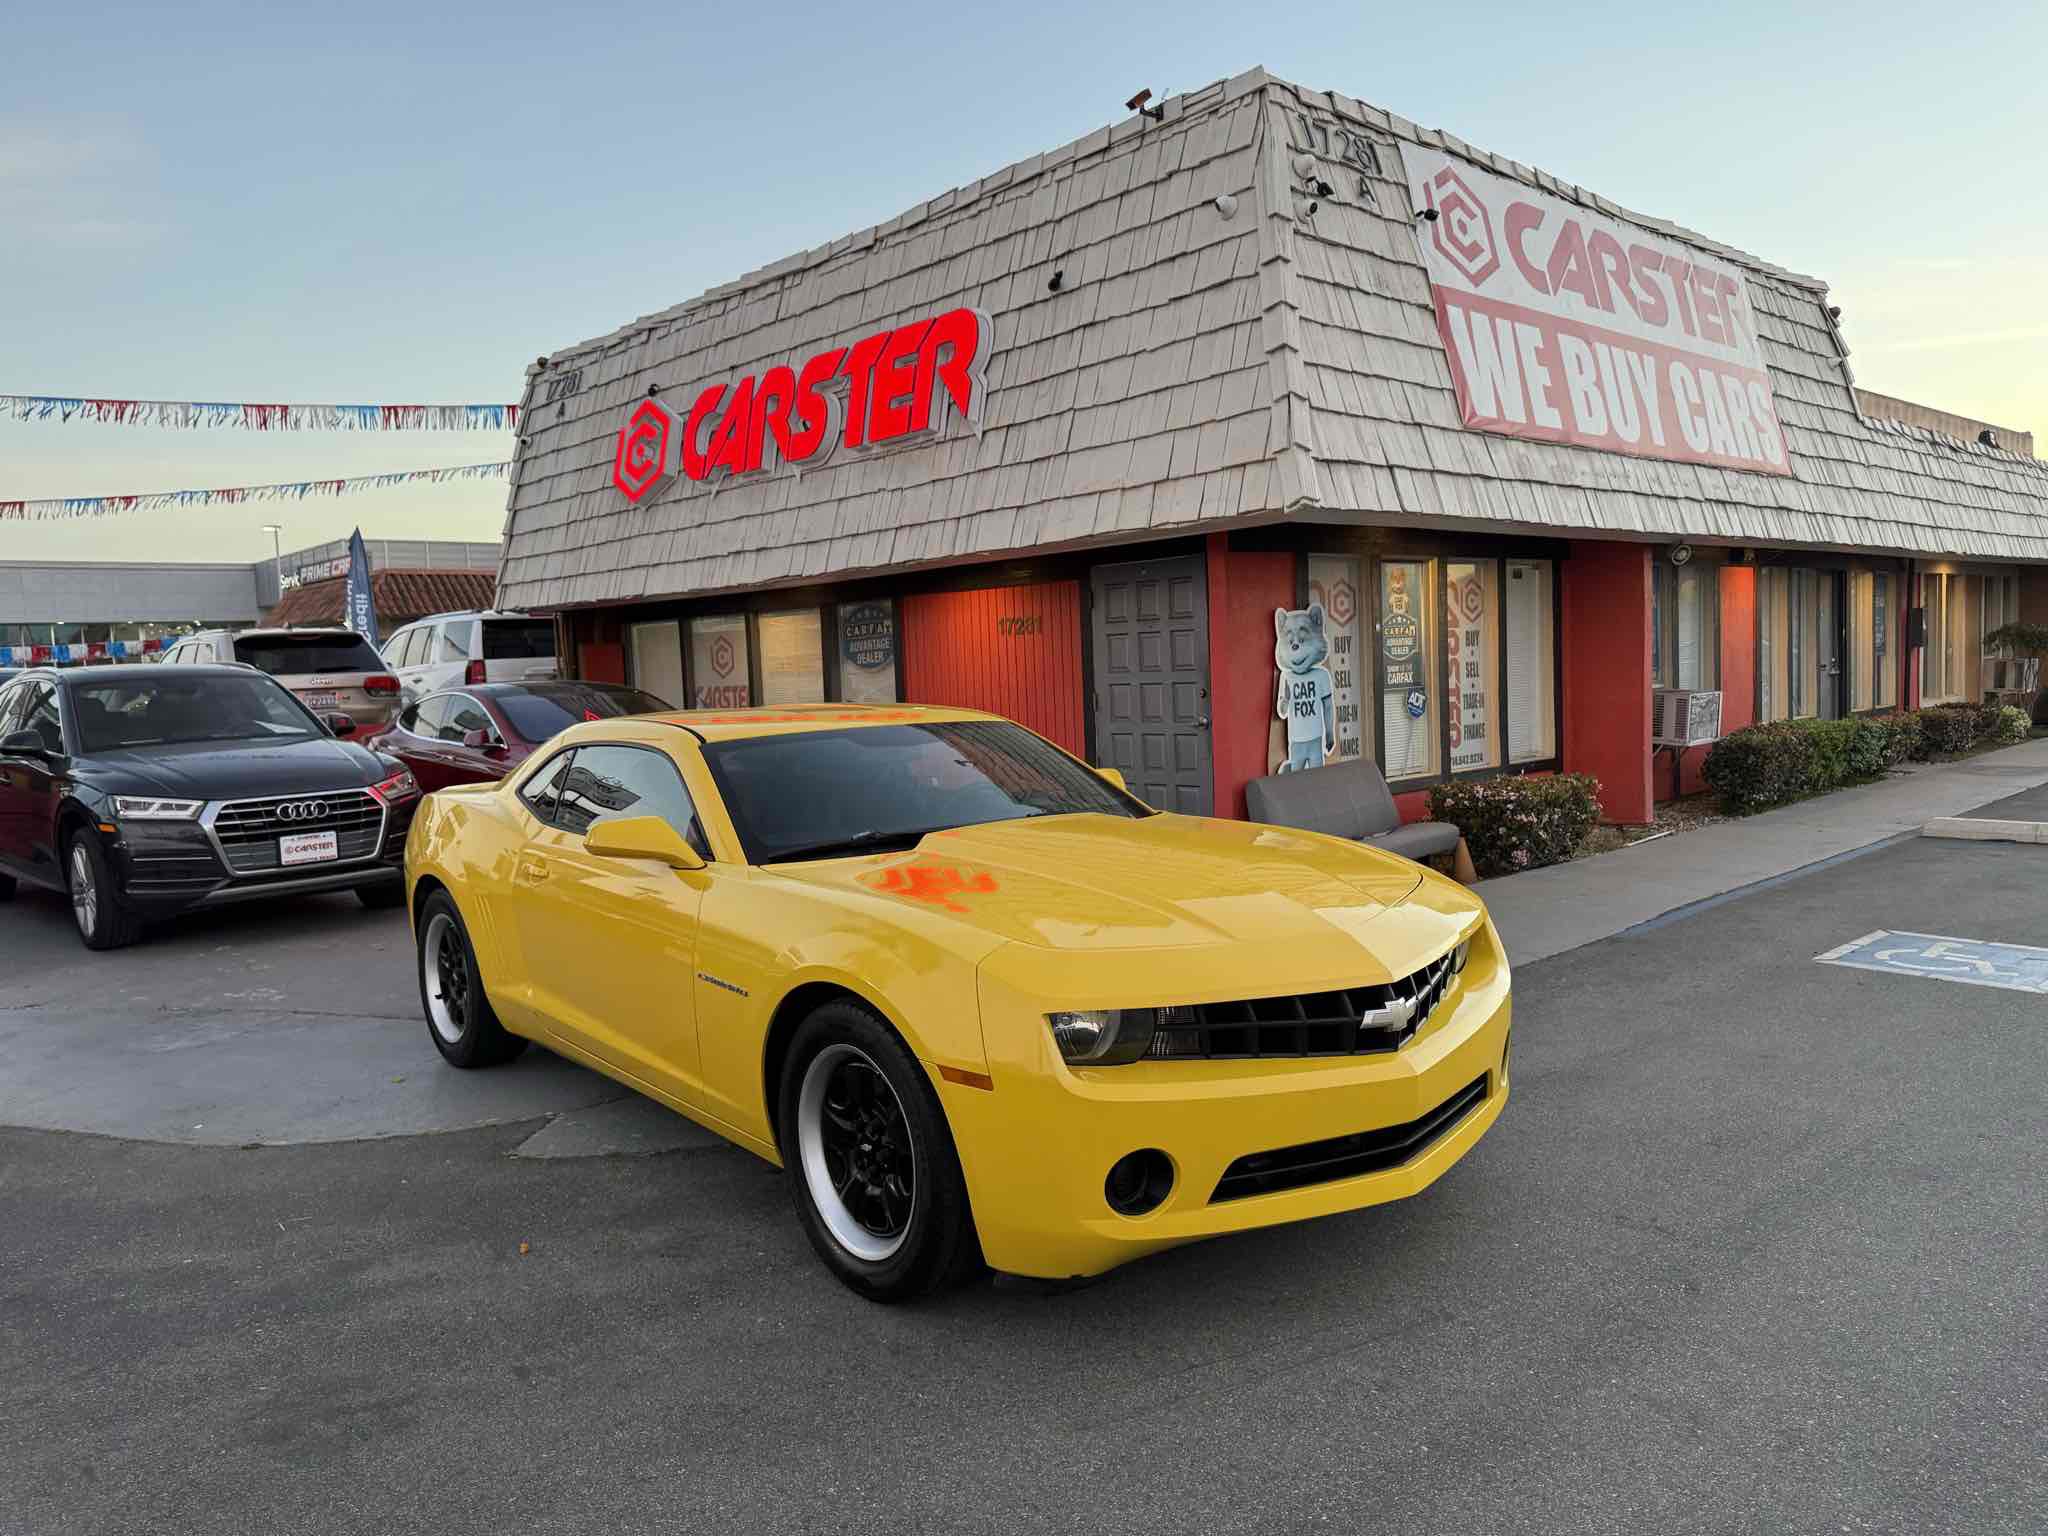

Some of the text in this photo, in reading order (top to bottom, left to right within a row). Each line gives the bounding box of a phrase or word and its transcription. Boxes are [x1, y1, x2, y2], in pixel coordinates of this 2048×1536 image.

[1359, 175, 1376, 202] A
[1503, 201, 1746, 350] CARSTER
[1446, 303, 1785, 467] WE BUY CARS
[681, 306, 988, 484] CARSTER
[300, 560, 331, 584] PRIME
[847, 622, 893, 637] CARFAX
[1465, 630, 1480, 647] BUY
[1335, 635, 1352, 654] BUY
[1334, 669, 1352, 689] SELL
[1386, 672, 1414, 685] CARFAX
[1465, 661, 1480, 678] SELL
[1293, 681, 1316, 699] CAR
[1408, 691, 1426, 707] ADT
[1294, 699, 1316, 718] FOX
[1463, 721, 1486, 741] FINANCE
